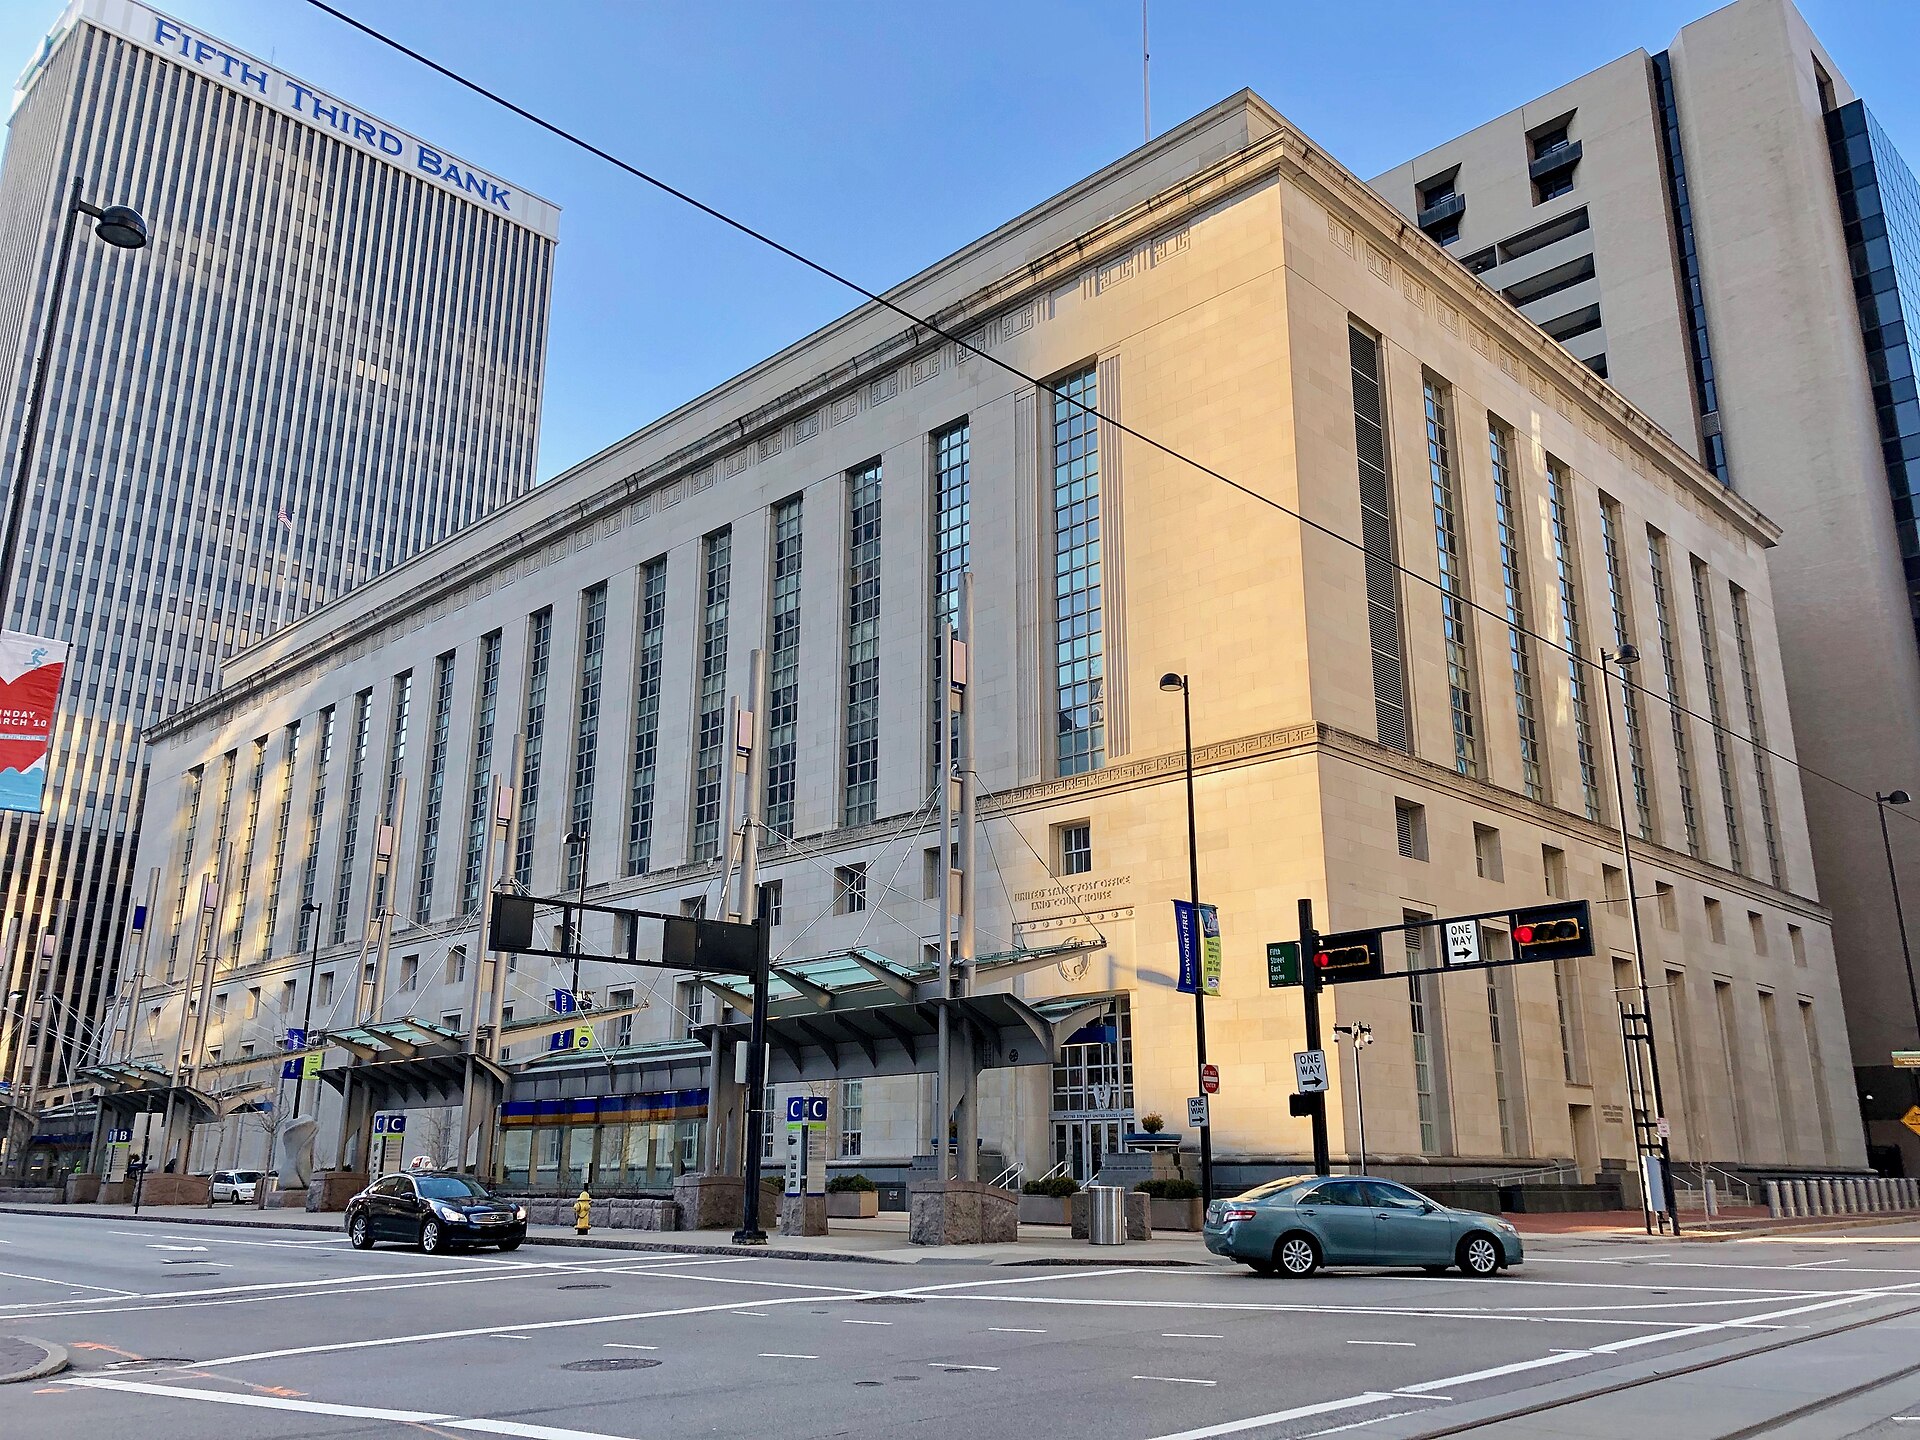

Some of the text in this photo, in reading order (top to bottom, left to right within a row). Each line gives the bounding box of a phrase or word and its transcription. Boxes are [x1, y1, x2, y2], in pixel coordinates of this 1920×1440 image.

[155, 17, 511, 212] FIFTH THIRD BANK
[0, 709, 35, 718] NDAY
[0, 718, 47, 727] RCH 10
[1014, 876, 1131, 902] UNITED STATES POST OFFICE
[1031, 899, 1052, 911] AND
[1451, 924, 1471, 935] ONE
[1451, 935, 1472, 946] WAY
[1270, 956, 1285, 964] Street
[1300, 1053, 1321, 1065] ONE
[1300, 1064, 1321, 1076] WAY
[790, 1100, 800, 1117] C
[812, 1100, 823, 1117] C
[1190, 1099, 1204, 1107] ONE
[1190, 1107, 1205, 1115] WAY
[391, 1118, 402, 1131] C
[120, 1130, 128, 1141] B
